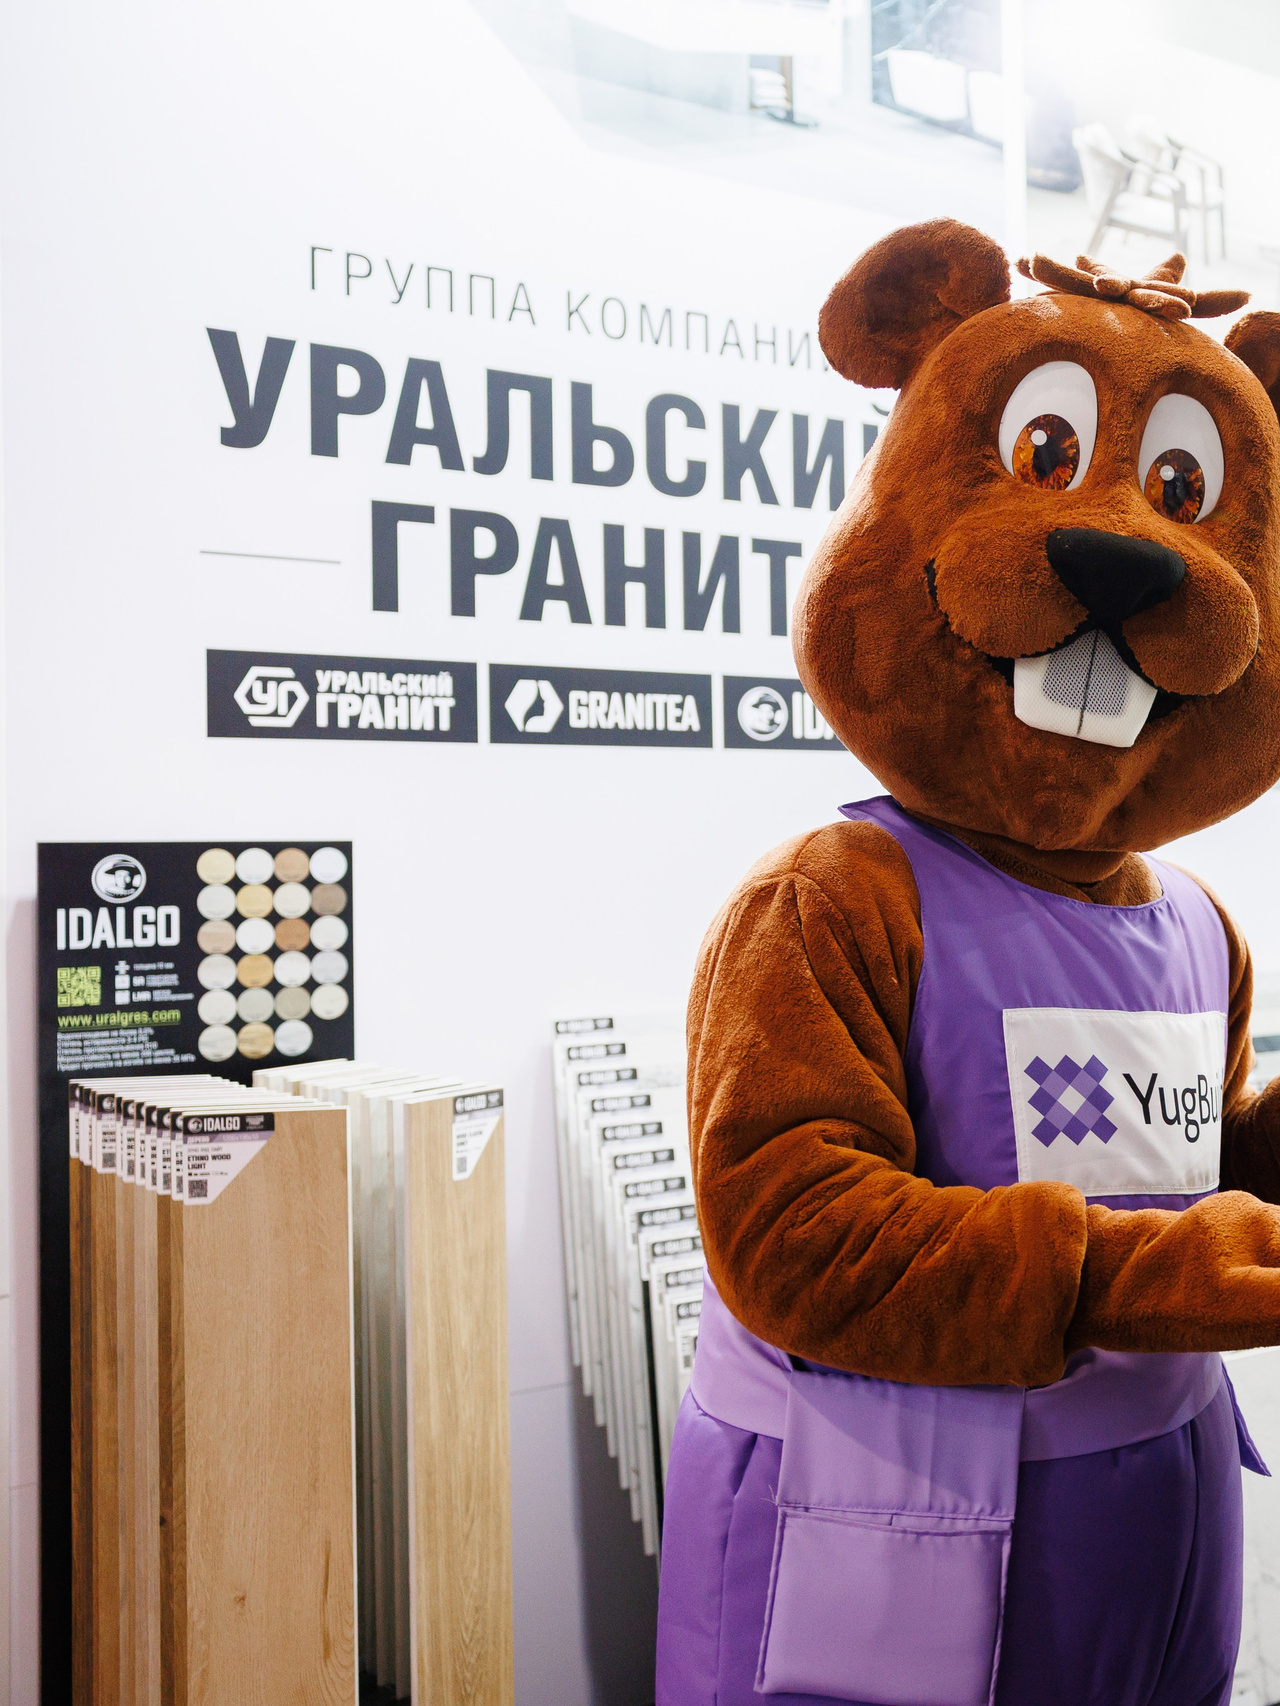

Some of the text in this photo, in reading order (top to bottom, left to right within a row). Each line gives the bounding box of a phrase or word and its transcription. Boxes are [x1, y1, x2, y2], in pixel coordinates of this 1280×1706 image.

[309, 246, 830, 372] ГРУППА КОМПАНИ
[371, 500, 803, 637] ГРАНИТ
[315, 669, 454, 697] УРАЛЬСКИЙ
[315, 692, 456, 732] ГРАНИТ
[568, 690, 701, 732] GRANITEA
[56, 905, 181, 951] IDALGO
[57, 1009, 182, 1028] www.uralgres.com
[204, 1116, 240, 1132] IDALGO
[187, 1154, 209, 1162] ETHNO
[211, 1153, 231, 1161] WOOD
[187, 1162, 206, 1170] LIGHT
